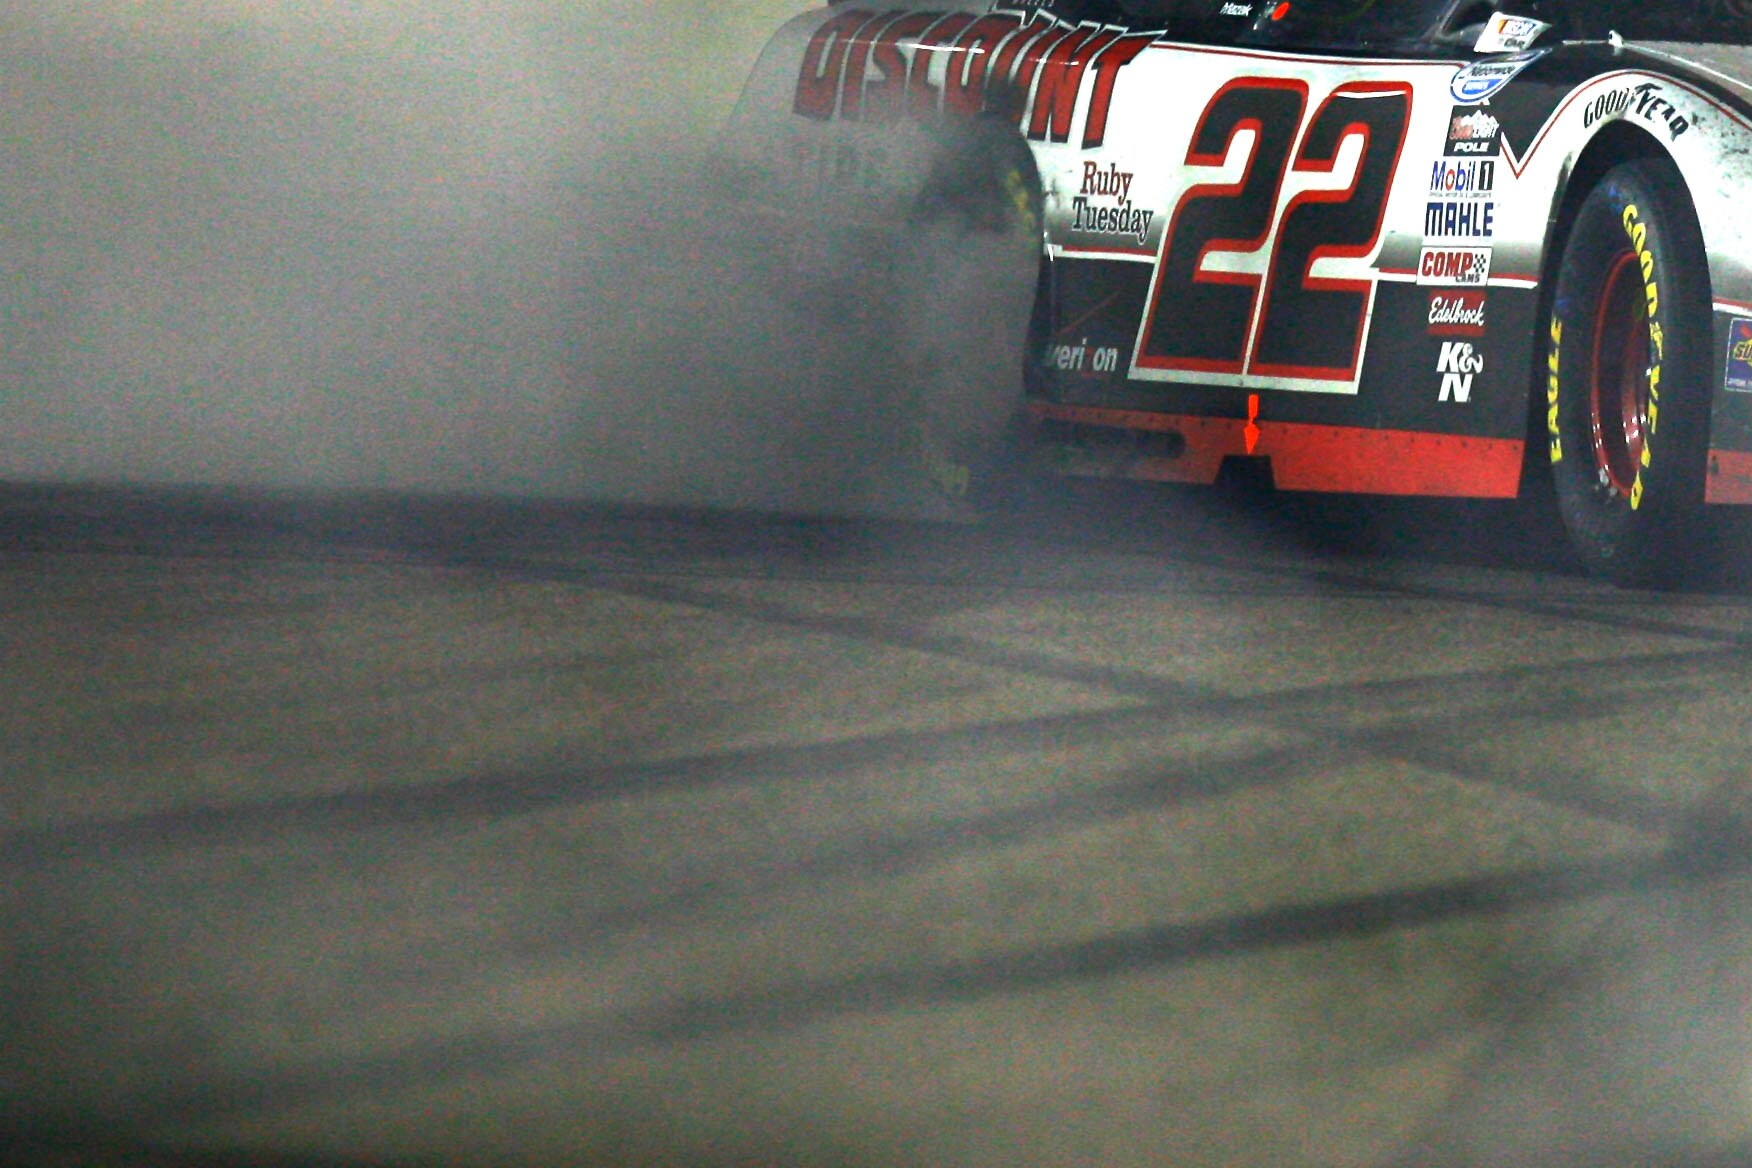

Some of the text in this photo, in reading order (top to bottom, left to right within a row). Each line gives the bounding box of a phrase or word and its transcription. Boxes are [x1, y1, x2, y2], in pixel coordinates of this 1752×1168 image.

[1583, 82, 1690, 142] GOODYEAR
[1453, 142, 1490, 152] POLE
[1080, 160, 1134, 206] Ruby
[1430, 160, 1477, 191] Mobil
[1072, 195, 1154, 243] Tuesday
[1136, 76, 1413, 384] 22
[1424, 201, 1494, 236] MAHLE
[1421, 251, 1474, 277] COMP
[1455, 273, 1481, 283] CAMS
[1428, 296, 1485, 326] Edelbrock
[1438, 373, 1473, 402] N
[1547, 316, 1562, 463] EAGLE
